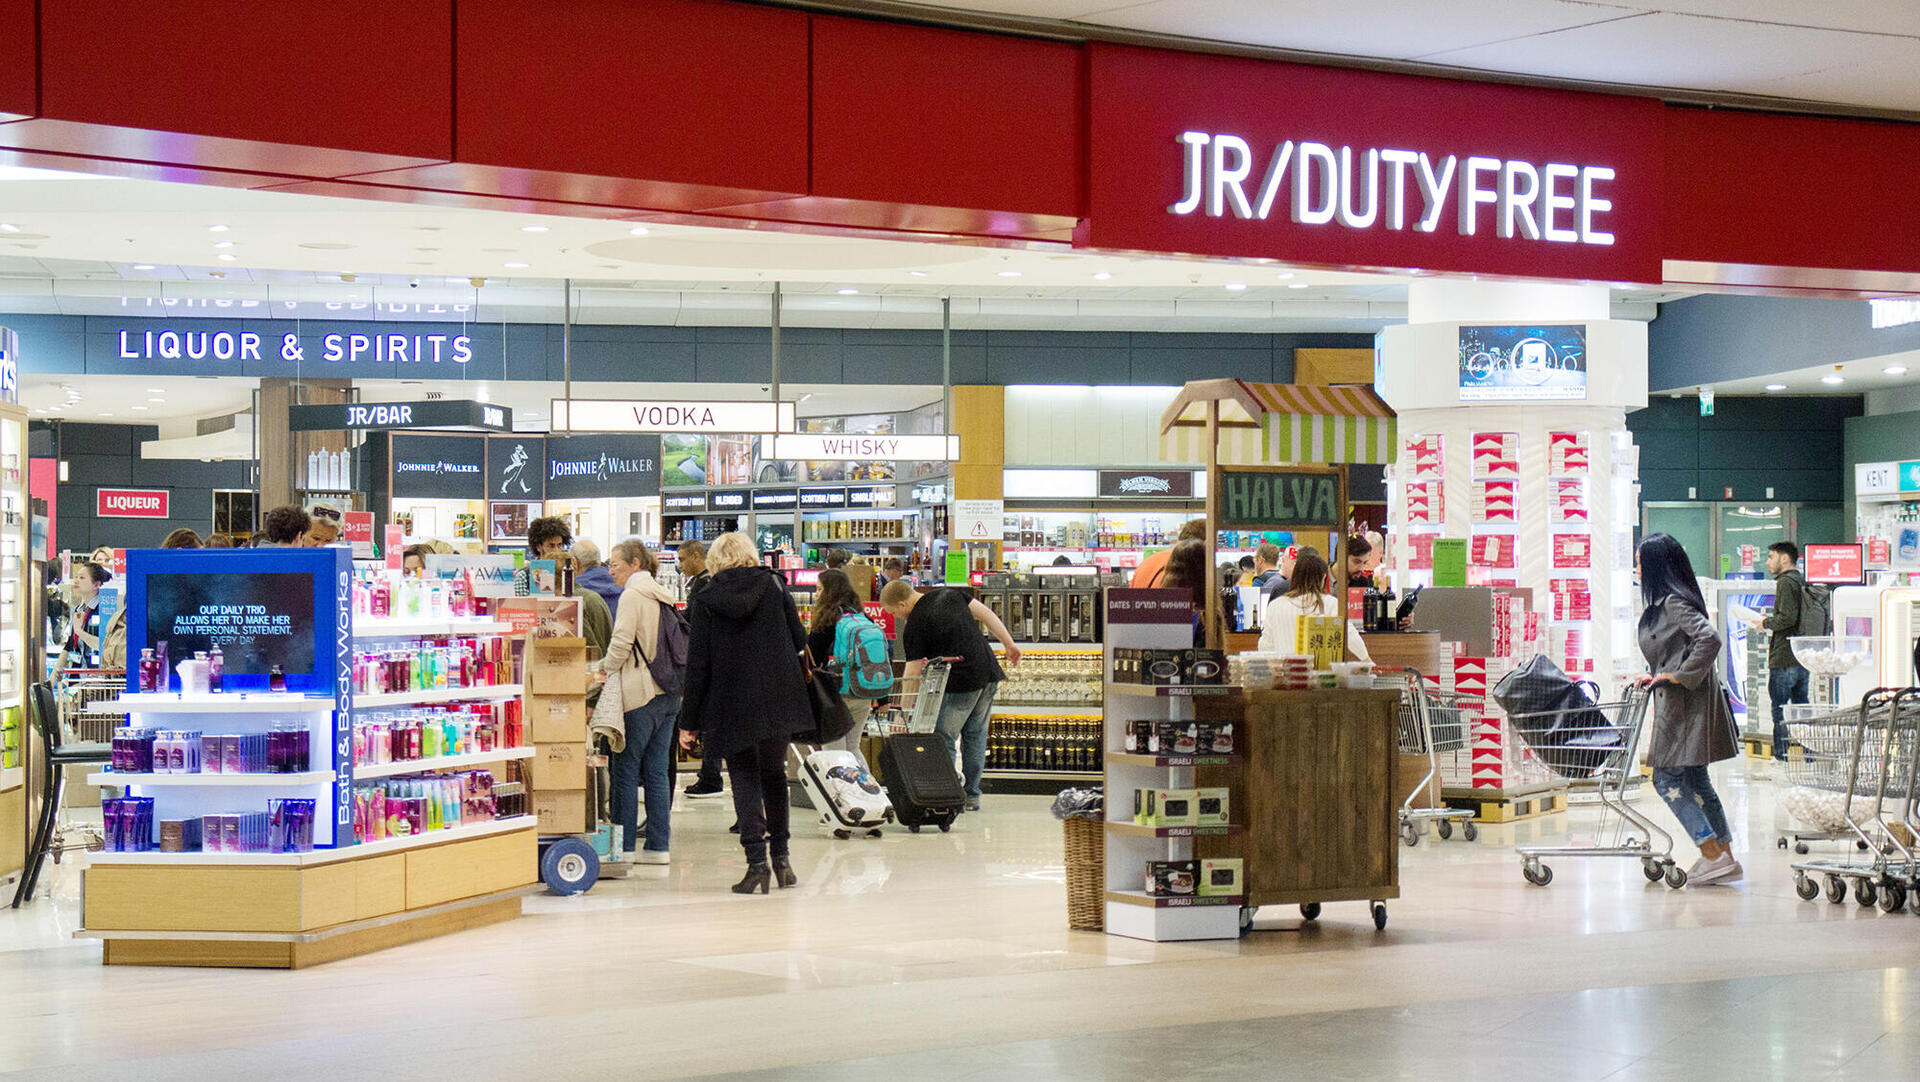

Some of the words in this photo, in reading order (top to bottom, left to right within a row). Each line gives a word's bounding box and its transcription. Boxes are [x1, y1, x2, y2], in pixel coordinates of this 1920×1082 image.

[119, 329, 262, 361] LIQUOR
[280, 333, 304, 361] &
[322, 333, 474, 363] SPIRITS
[347, 405, 412, 426] JR/BAR
[633, 406, 715, 426] VODKA
[822, 438, 900, 455] WHISKY
[398, 461, 435, 472] JOHNNIE
[550, 460, 597, 480] JOHNNIE
[608, 457, 653, 473] WALKER
[1866, 470, 1887, 487] KENT
[106, 496, 160, 510] LIQUEUR
[1227, 477, 1337, 519] HALVA
[454, 567, 505, 582] AAVA
[199, 605, 218, 614] OUR
[220, 605, 244, 614] DAILY
[246, 605, 266, 614] TRIO
[864, 606, 883, 617] PAY
[1109, 601, 1131, 609] DATES
[175, 616, 209, 625] ALLOWS
[211, 616, 229, 624] HER
[231, 616, 243, 624] TO
[245, 616, 270, 624] MAKE
[272, 616, 290, 624] HER
[336, 571, 349, 658] Works
[173, 626, 194, 635] OWN
[196, 626, 240, 635] PERSONAL
[210, 636, 237, 645] EVERY
[240, 636, 256, 645] DAY
[338, 661, 351, 732] Body
[1168, 687, 1192, 695] ISRAELI
[338, 739, 349, 757] &
[1168, 757, 1192, 765] ISRAELI
[338, 761, 350, 825] Bath
[1168, 827, 1192, 835] ISRAELI
[1168, 898, 1192, 906] ISRAELI
